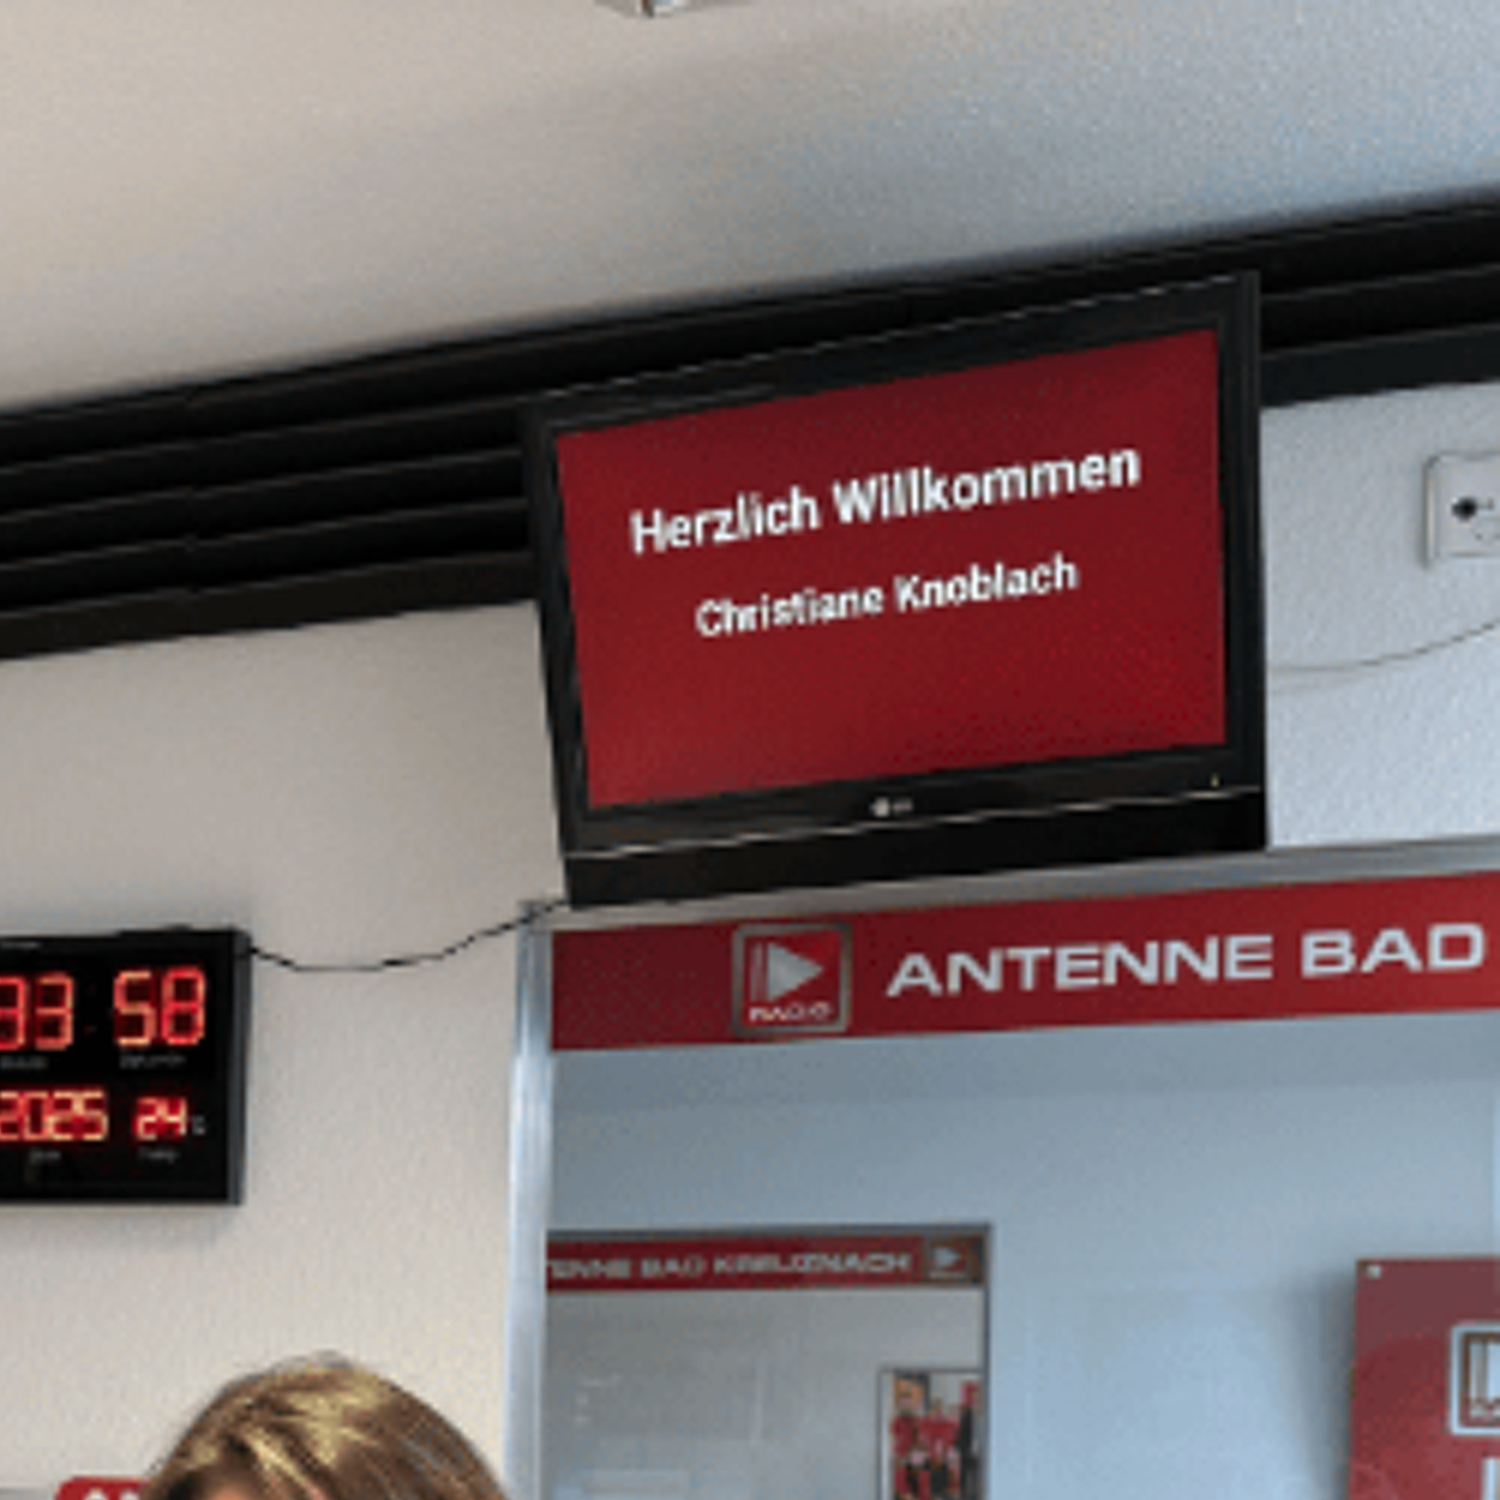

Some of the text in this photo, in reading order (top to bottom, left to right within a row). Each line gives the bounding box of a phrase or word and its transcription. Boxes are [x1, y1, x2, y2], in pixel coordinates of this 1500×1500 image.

[630, 446, 1142, 555] Herzlich Willkommen
[695, 551, 1081, 638] Christiane Knoblach
[886, 923, 1485, 998] ANTENNE BAD
[113, 966, 206, 1047] 58
